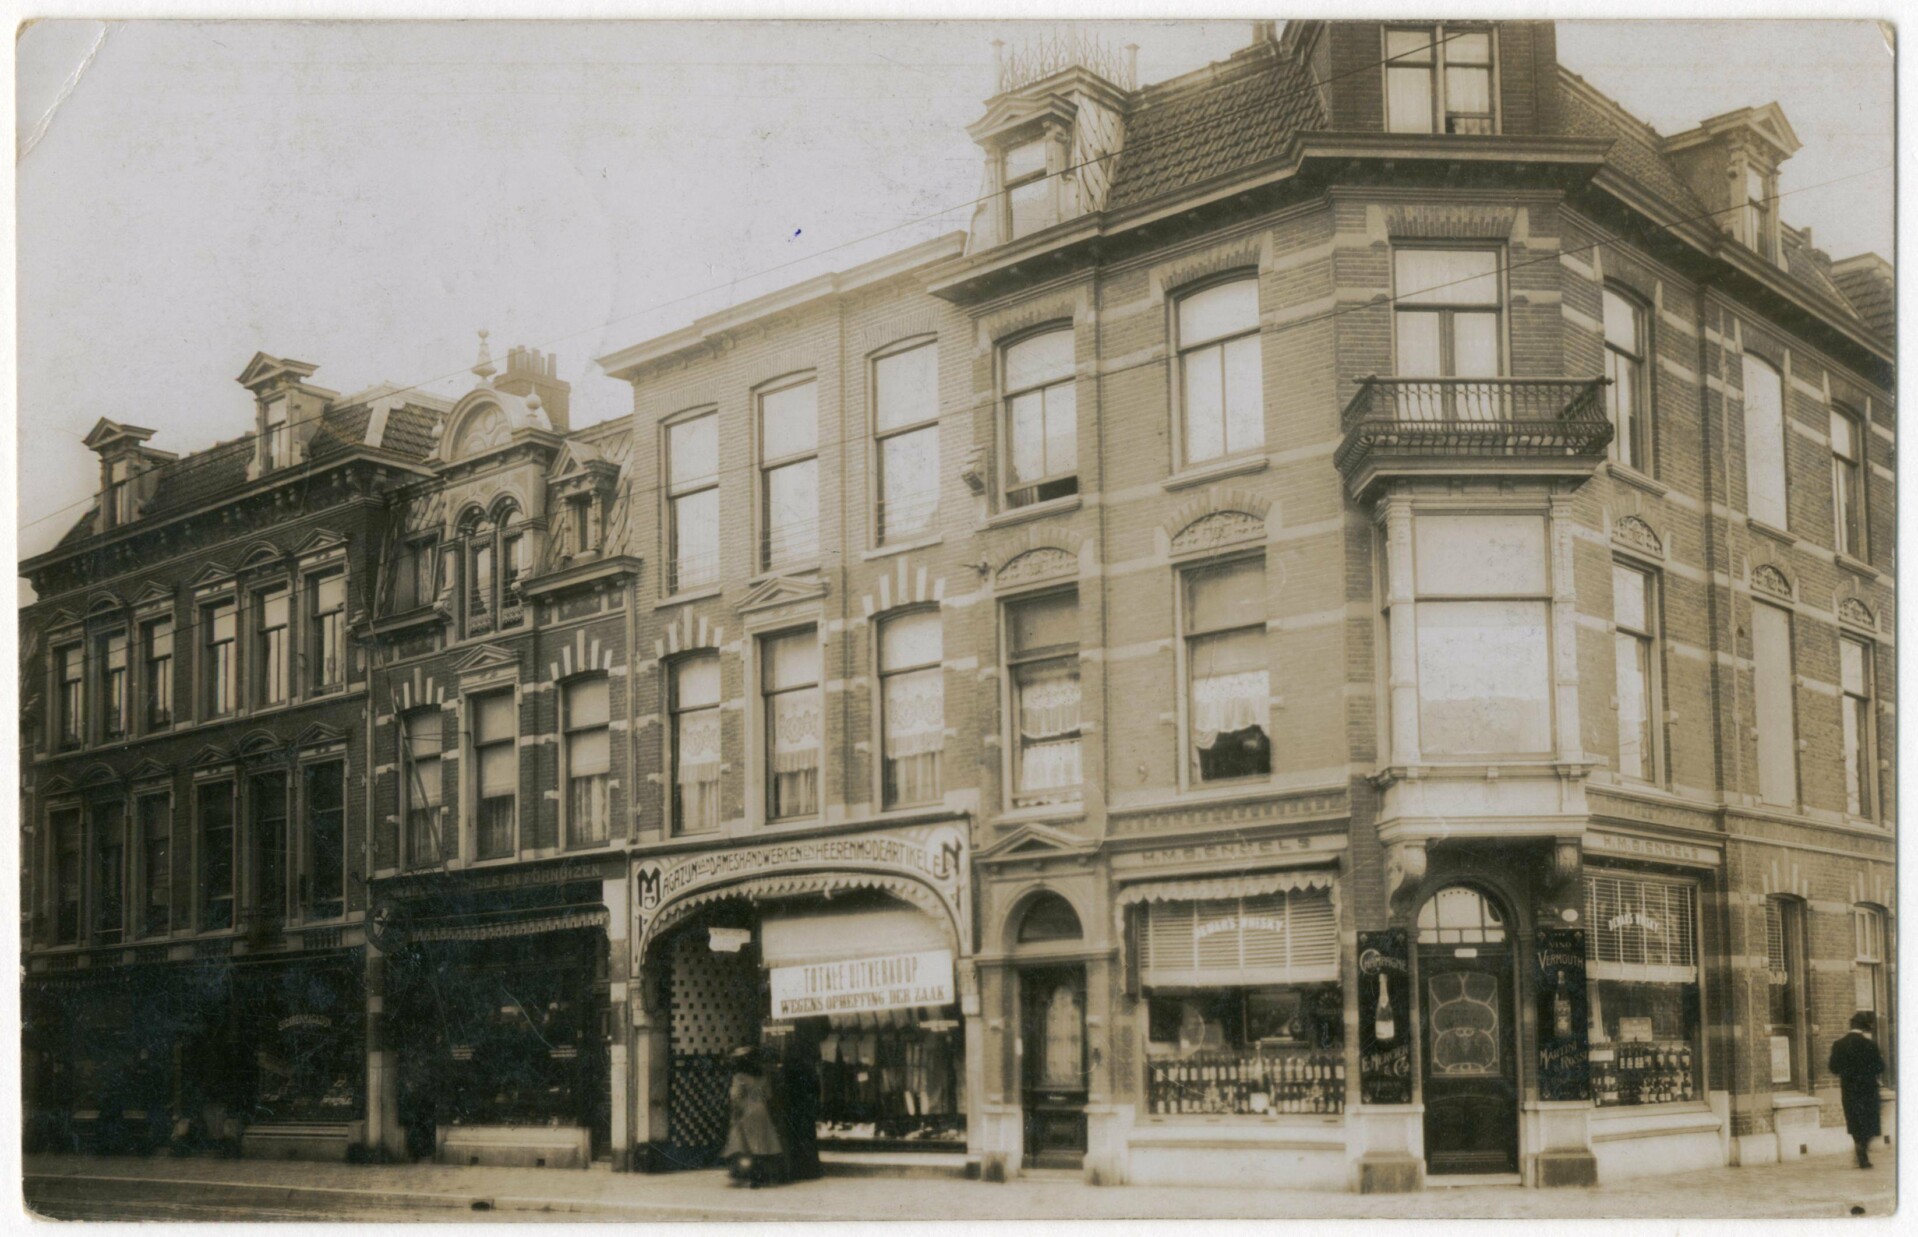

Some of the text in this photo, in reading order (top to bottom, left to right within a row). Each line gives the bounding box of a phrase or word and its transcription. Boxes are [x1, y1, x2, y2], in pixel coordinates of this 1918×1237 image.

[710, 847, 802, 876] DAMESHANDWERKEN
[816, 836, 964, 881] HEERENMODEARTIKELEN
[1537, 949, 1584, 969] VERMOUTH
[803, 964, 847, 994] TOTALE
[780, 984, 944, 1015] WEGENS OPHEFFING DER ZAAK
